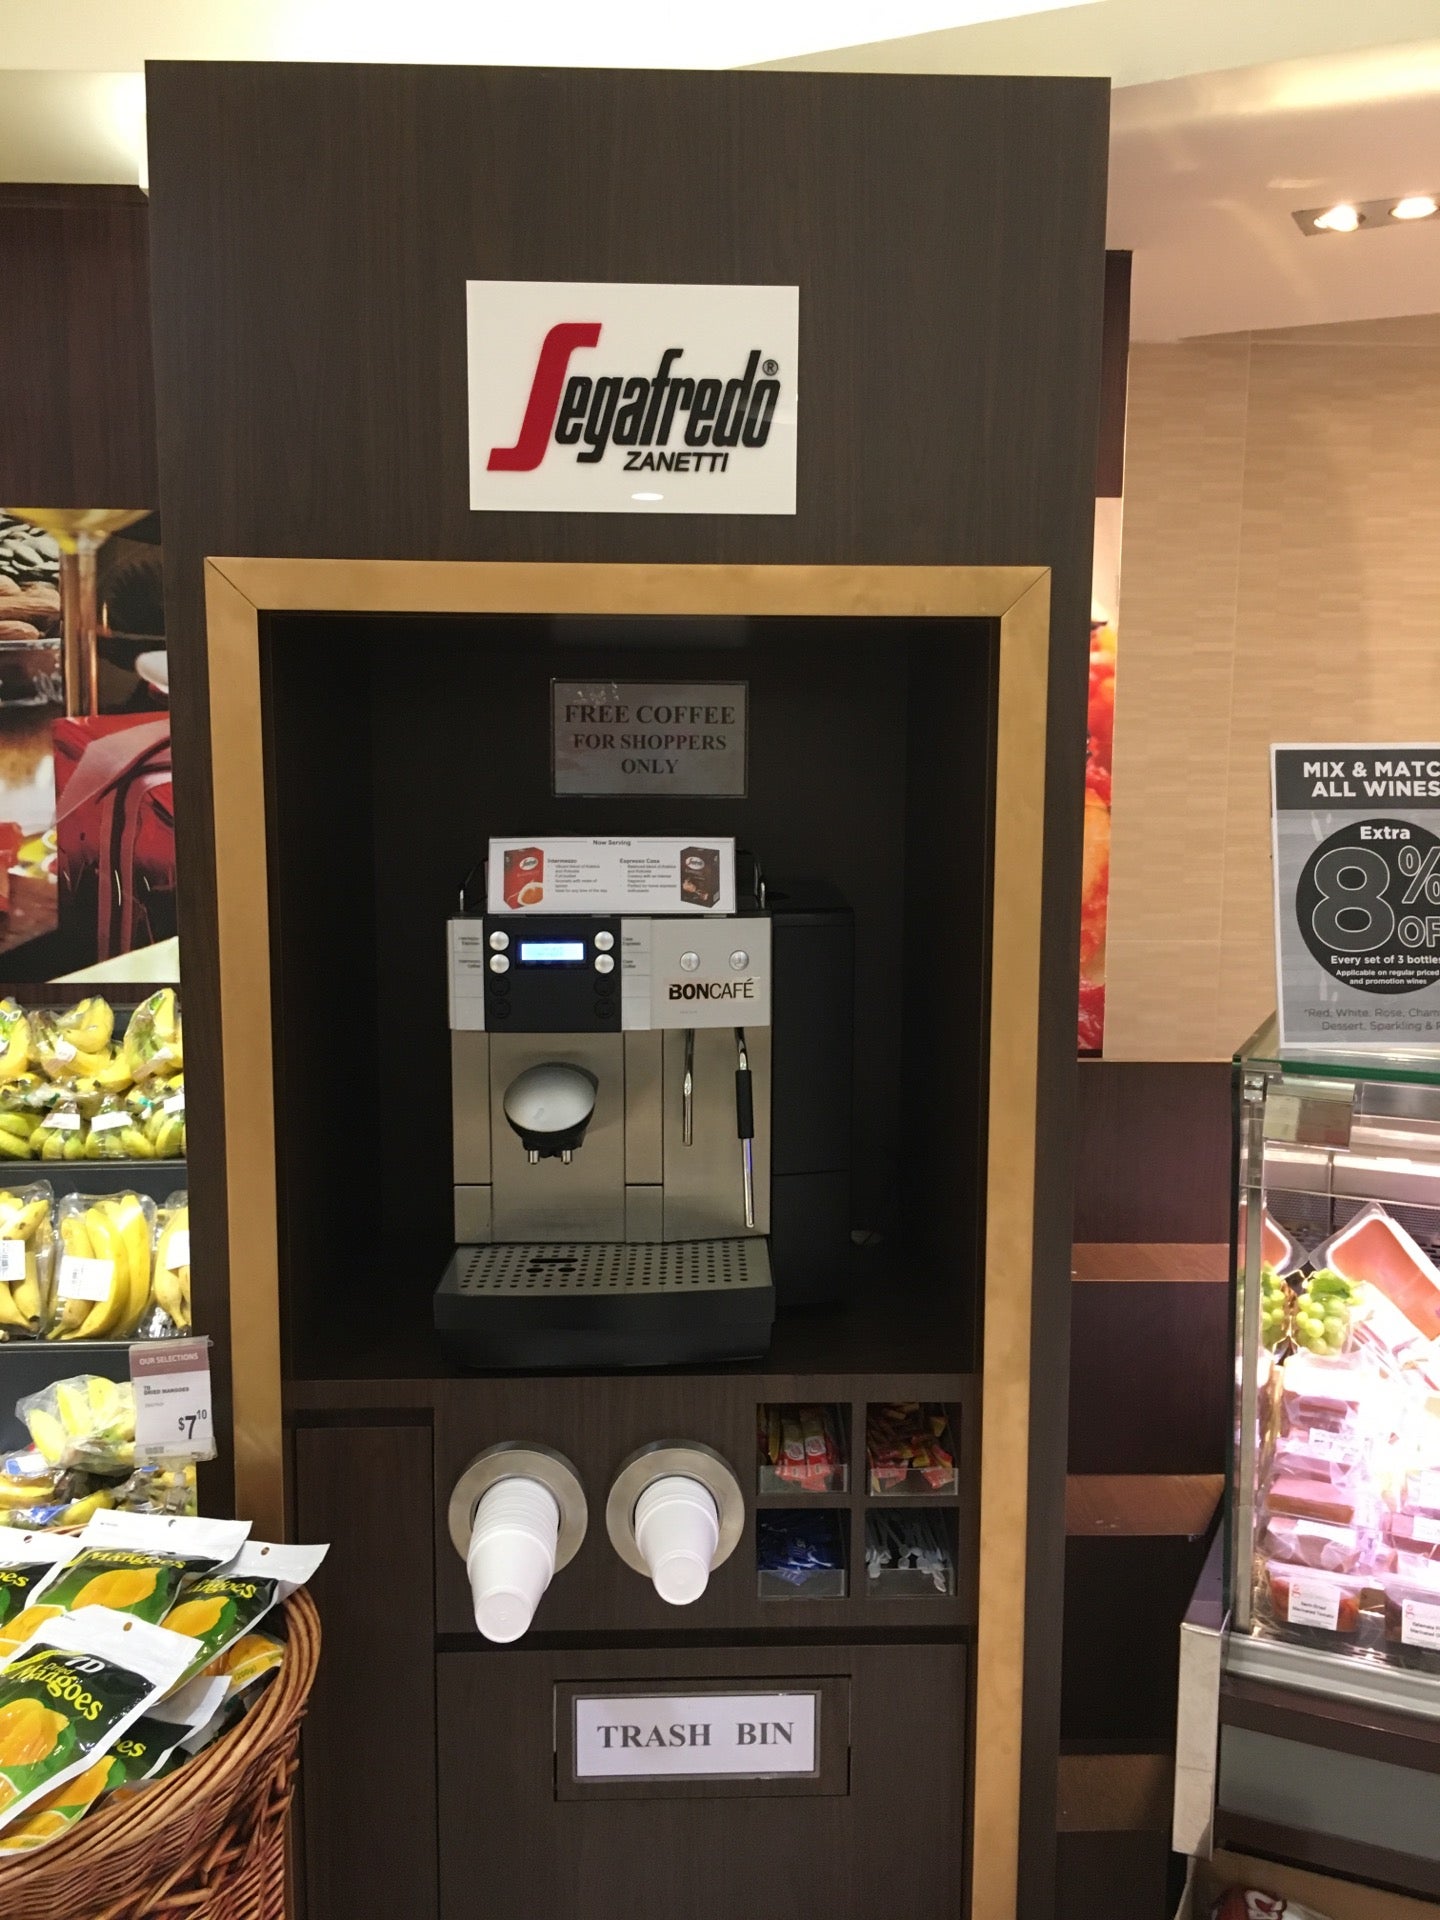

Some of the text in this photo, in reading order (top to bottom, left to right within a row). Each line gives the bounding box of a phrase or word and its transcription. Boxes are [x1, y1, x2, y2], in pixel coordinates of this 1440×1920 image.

[623, 451, 729, 472] ZANETTI
[565, 705, 735, 724] FREE COFFEE
[574, 733, 726, 750] FOR SHOPPERS
[621, 758, 679, 774] ONLY
[1303, 761, 1440, 778] MIX & MATC
[1311, 780, 1440, 797] ALL WINES
[1360, 826, 1411, 840] Extra
[608, 839, 631, 847] Serving
[1331, 955, 1361, 966] Every
[1364, 956, 1380, 965] set
[1383, 955, 1394, 964] of
[1398, 955, 1404, 964] 3
[1336, 969, 1375, 977] Applicable
[1389, 969, 1414, 978] regular
[1416, 969, 1440, 977] priced
[669, 978, 754, 1000] BONCAFÉ
[1365, 978, 1404, 986] promotion
[1370, 1020, 1422, 1032] Sparkling
[139, 1352, 198, 1366] OUR SELECTIONS
[10, 1664, 103, 1720] Mangoes
[597, 1722, 794, 1748] TRASH BIN
